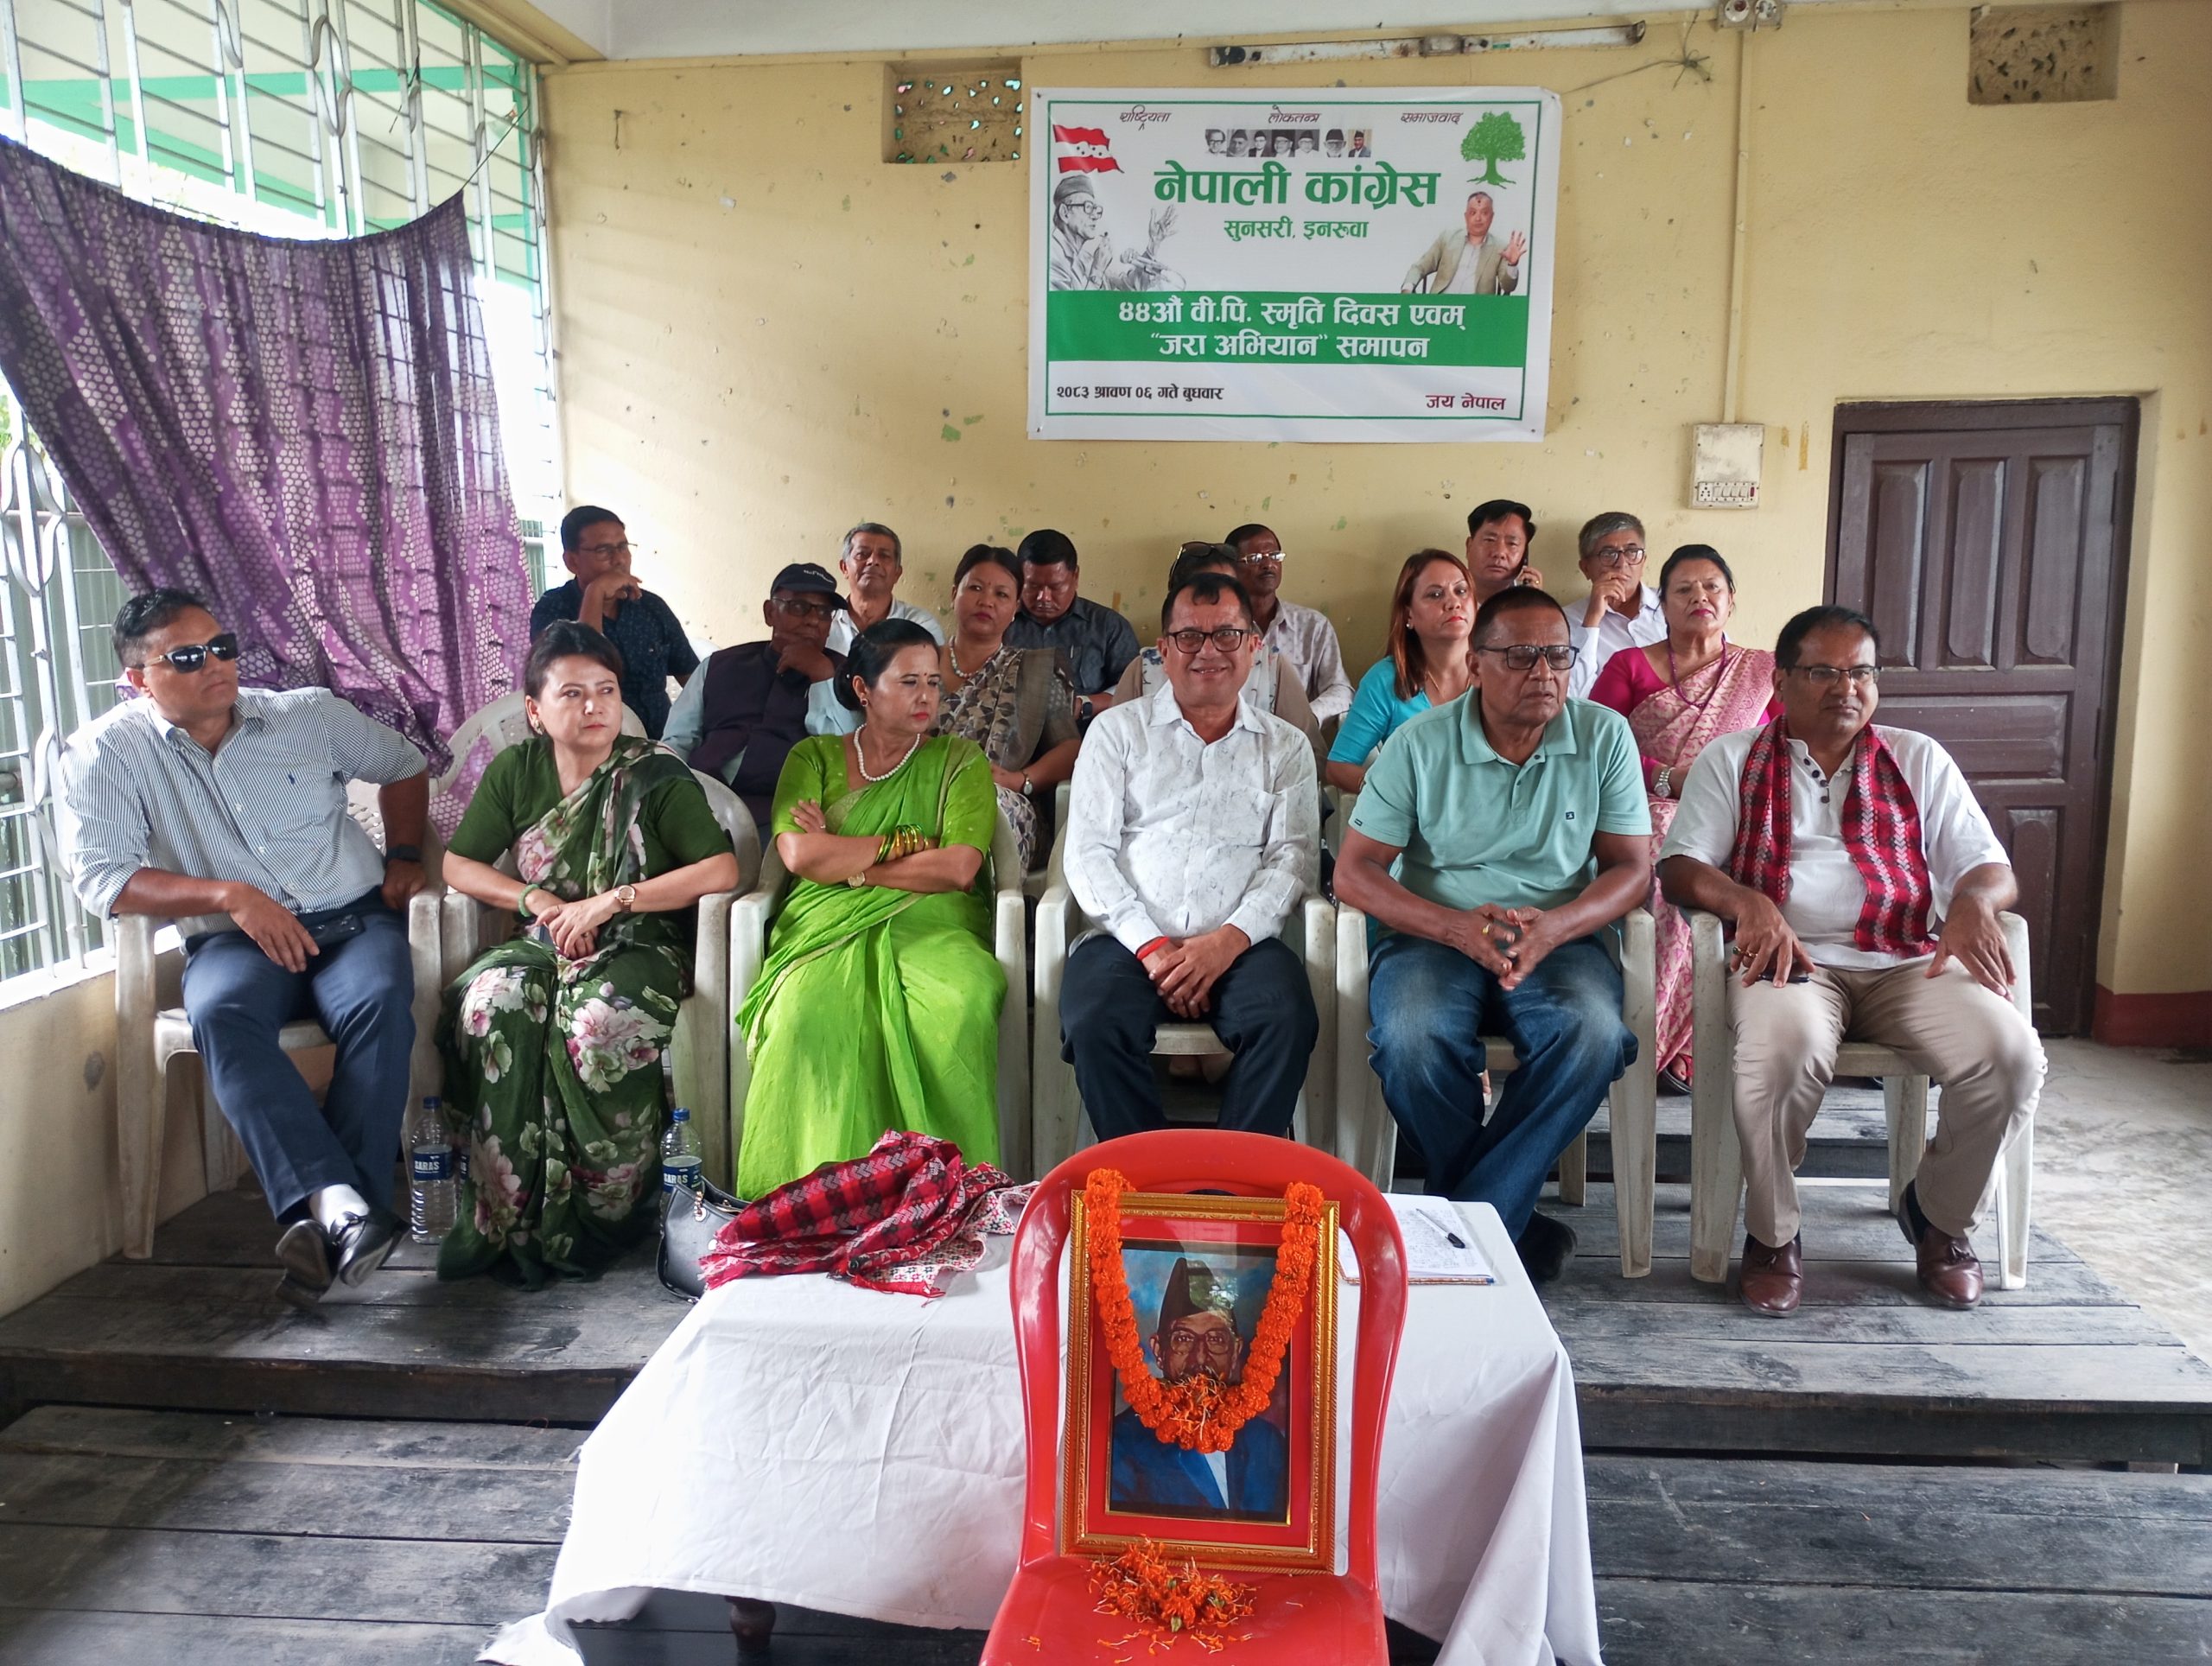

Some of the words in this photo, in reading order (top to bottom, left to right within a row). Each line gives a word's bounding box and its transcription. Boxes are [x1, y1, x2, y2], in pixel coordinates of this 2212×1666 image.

[1401, 112, 1464, 124] समाजवाद
[1154, 160, 1292, 206] नेपाली
[1305, 161, 1441, 209] कांग्रेस
[1261, 296, 1325, 329] स्मृति
[1334, 296, 1401, 326] दिवस
[1409, 304, 1465, 331] एवम्
[1337, 336, 1431, 358] समापन
[1057, 386, 1090, 398] २०८३
[1095, 386, 1132, 398] श्रावण
[1135, 387, 1152, 399] ०६
[1158, 384, 1179, 398] गते
[1183, 387, 1224, 402] बुधवार
[1425, 395, 1455, 409] जय
[1461, 392, 1506, 410] नेपाल
